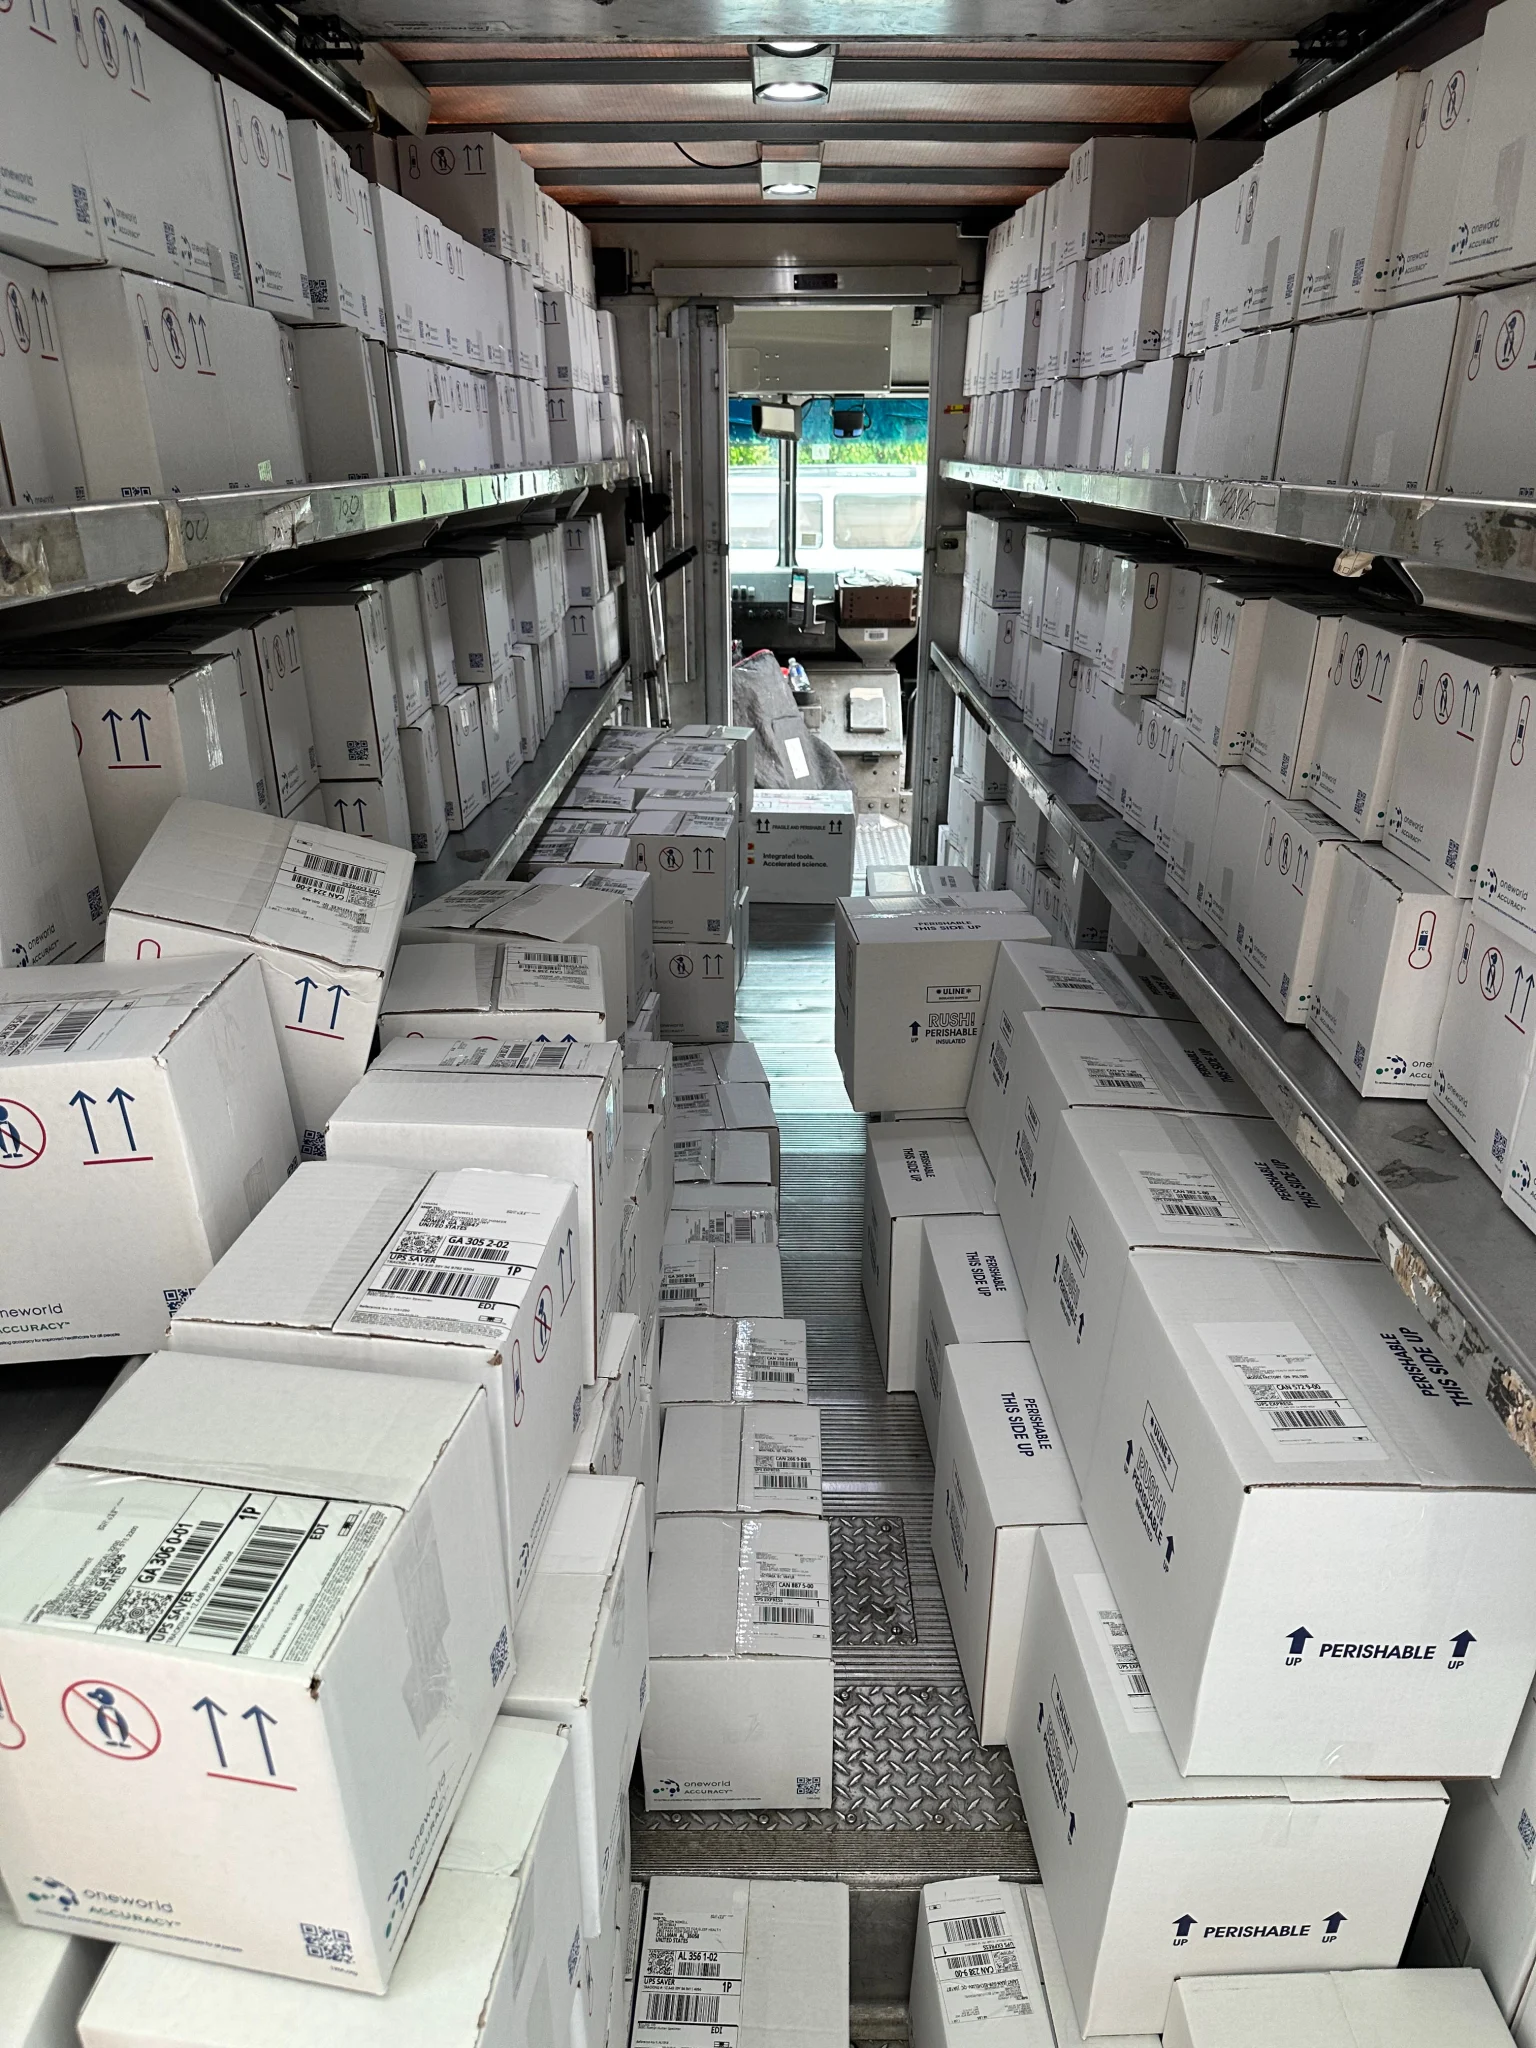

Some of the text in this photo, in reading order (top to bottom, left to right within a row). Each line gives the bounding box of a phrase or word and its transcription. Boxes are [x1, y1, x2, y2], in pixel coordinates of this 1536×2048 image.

[1404, 816, 1424, 834] oneworld
[763, 853, 796, 861] Integrated
[295, 883, 345, 901] CAN 224 2-00
[1500, 879, 1529, 902] oneworld
[27, 923, 56, 951] oneworld
[942, 987, 966, 995] ULINE
[925, 1027, 978, 1038] PERISHABLE
[928, 1012, 976, 1027] RUSH!
[1447, 1082, 1468, 1109] oneworld
[903, 1147, 922, 1182] THIS SIDE UP
[918, 1150, 936, 1178] PERISHABLE
[1254, 1161, 1295, 1202] PERISHABLE
[1270, 1158, 1321, 1209] THIS SIDE UP
[448, 1236, 510, 1249] GA 305 2-02
[389, 1254, 438, 1264] UPS SAVER
[507, 1266, 522, 1276] 1P
[966, 1251, 992, 1297] THIS SIDE UP
[984, 1255, 1007, 1292] PERISHABLE
[0, 1302, 63, 1319] neworld
[477, 1302, 497, 1311] EDI
[1379, 1332, 1440, 1397] PERISHABLE
[1398, 1326, 1473, 1407] THIS SIDE UP
[1306, 1383, 1321, 1391] 9-00
[1000, 1392, 1035, 1457] THIS SIDE UP
[1023, 1398, 1052, 1450] PERISHABLE
[1153, 1424, 1168, 1458] ULINE
[1136, 1446, 1167, 1526] RUSH!
[235, 1505, 265, 1521] 1P
[1131, 1468, 1164, 1546] PERISHABLE
[1135, 1497, 1153, 1542] INSULATED
[307, 1522, 332, 1541] EDI
[135, 1521, 195, 1584] GA 306 0-01
[68, 1588, 100, 1618] ATHENS
[92, 1575, 109, 1587] GA
[102, 1552, 127, 1574] 30606
[78, 1591, 109, 1620] UNITED
[100, 1565, 128, 1591] STATES
[148, 1589, 198, 1641] UPS SAVER
[163, 1614, 192, 1643] TRACKING
[1285, 1643, 1465, 1670] UP PERISHABLE UP
[410, 1768, 446, 1860] oneworld
[82, 1887, 174, 1914] oneworld
[982, 1943, 1004, 1951] EXPRESS
[1173, 1925, 1338, 1947] UP PERISHABLE UP
[677, 1951, 718, 1962] AL 356 1-02
[942, 1946, 947, 1955] 1
[655, 1977, 676, 1985] SAVER
[954, 1965, 995, 1978] CAN 238 9-00
[721, 1981, 732, 1992] 1P
[710, 2025, 723, 2034] EDI
